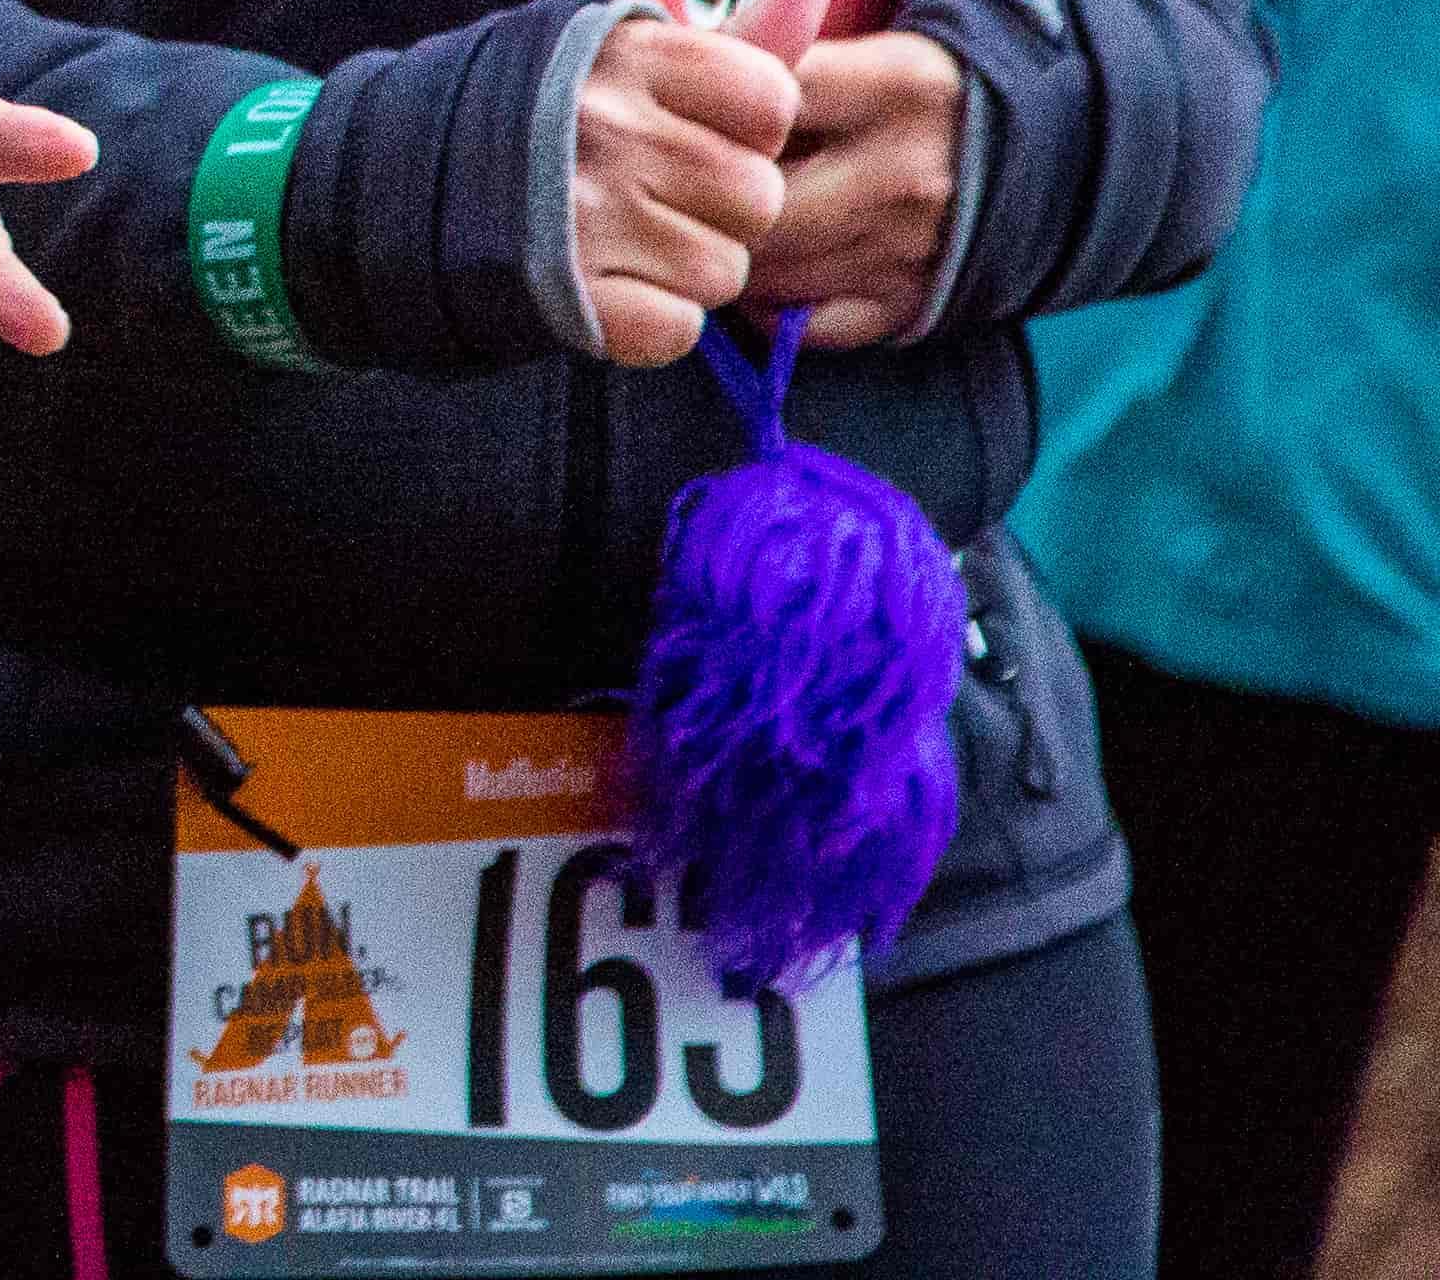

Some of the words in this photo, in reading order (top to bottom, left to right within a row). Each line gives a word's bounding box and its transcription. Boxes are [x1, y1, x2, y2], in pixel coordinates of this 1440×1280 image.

[466, 844, 803, 1134] 163
[192, 1073, 297, 1109] RAGNAR
[303, 1067, 409, 1102] RUNNER
[297, 1176, 391, 1206] RAGNAR
[393, 1175, 458, 1206] TRAIL
